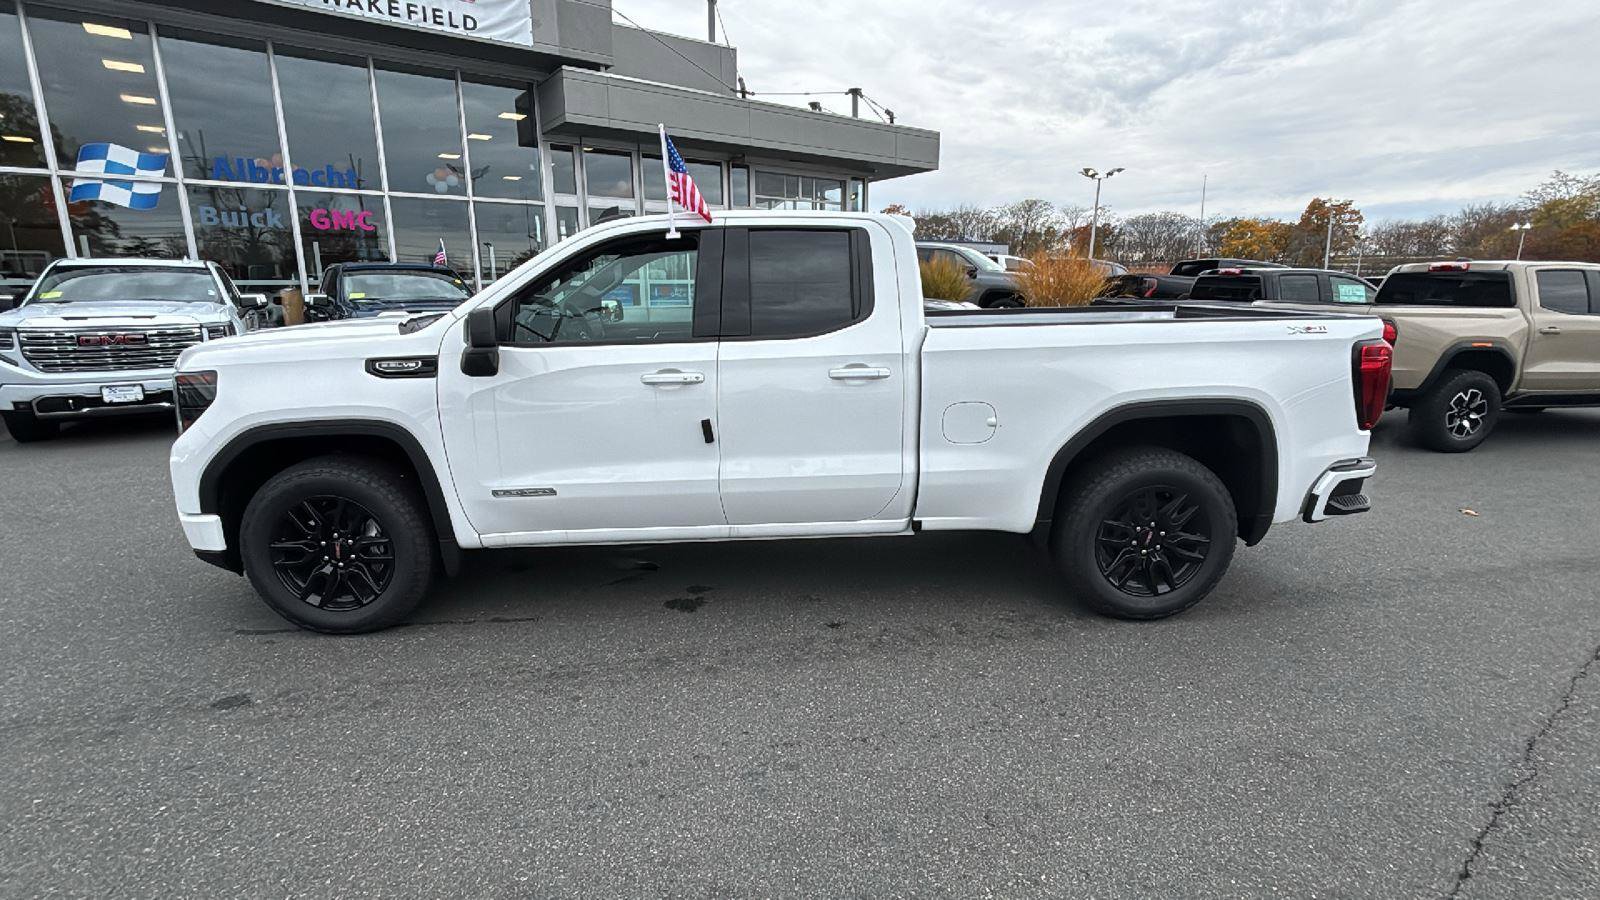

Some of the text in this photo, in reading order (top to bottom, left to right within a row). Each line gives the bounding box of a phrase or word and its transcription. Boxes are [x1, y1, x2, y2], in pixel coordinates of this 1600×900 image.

[322, 0, 478, 31] AKEFIELD
[212, 154, 358, 189] Albrecht
[199, 205, 376, 231] Buick GMC
